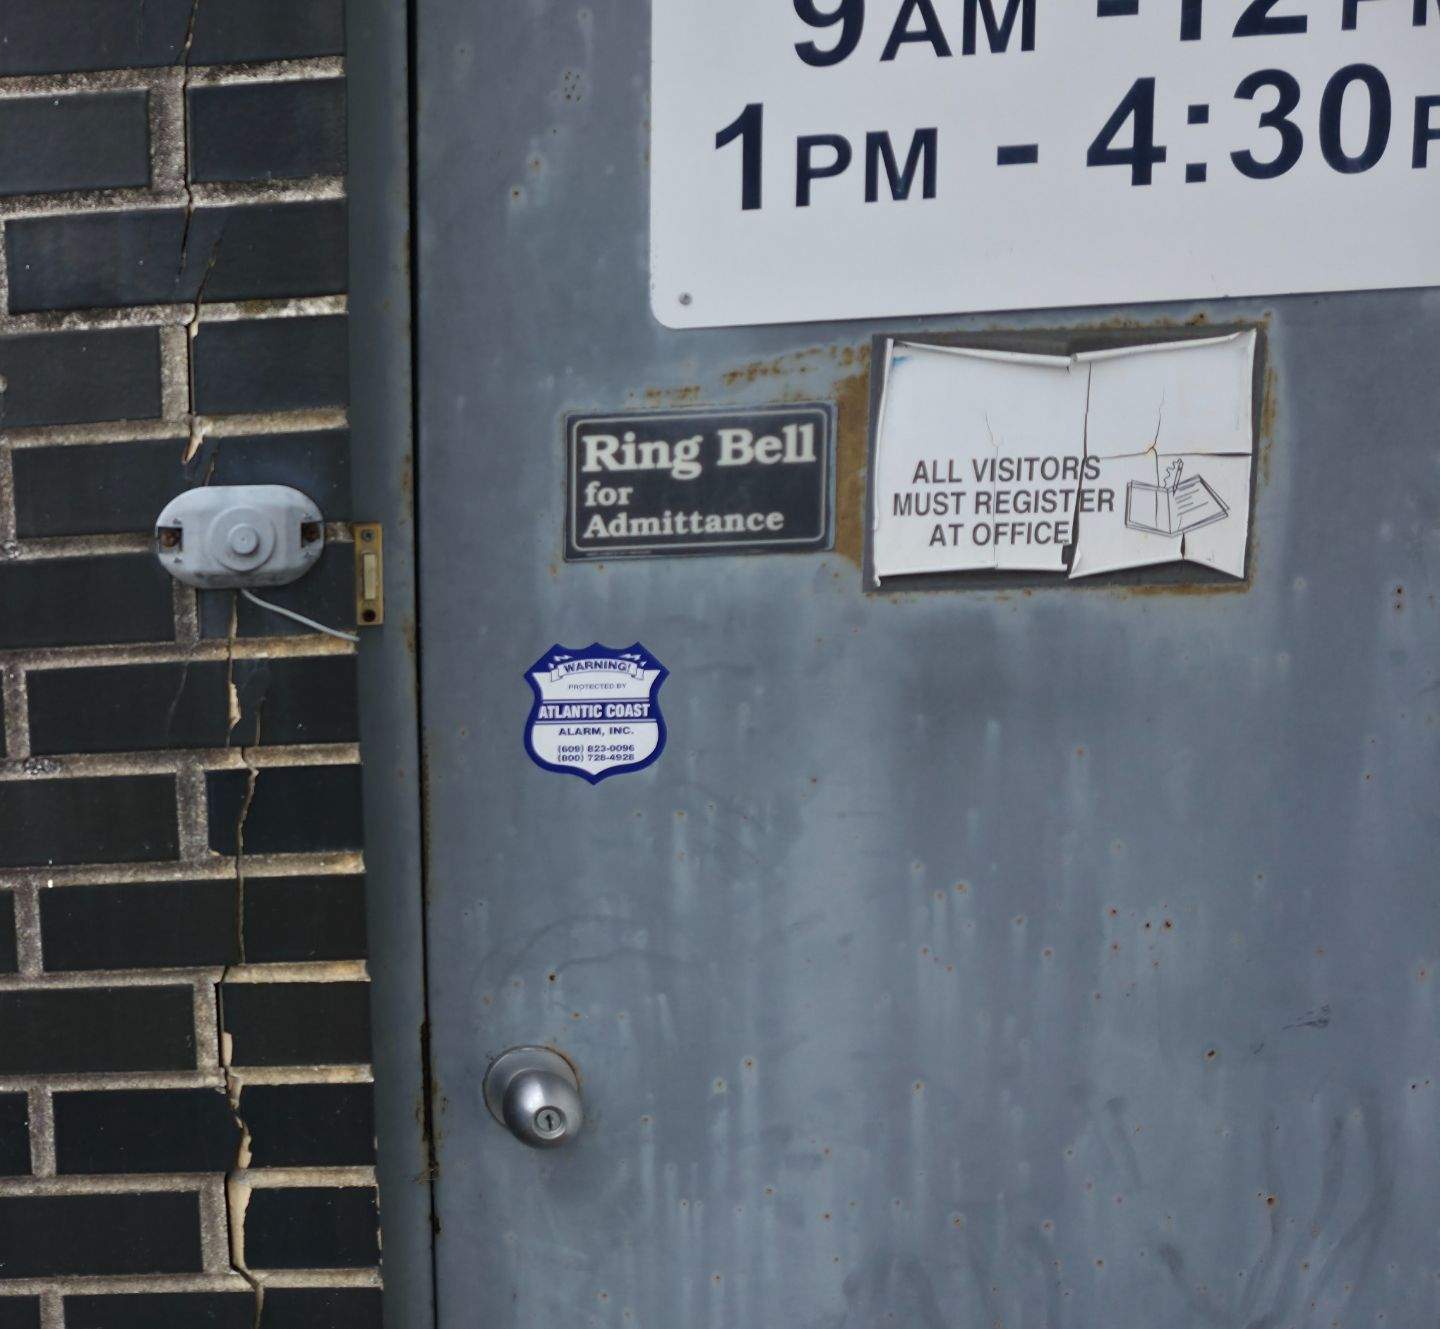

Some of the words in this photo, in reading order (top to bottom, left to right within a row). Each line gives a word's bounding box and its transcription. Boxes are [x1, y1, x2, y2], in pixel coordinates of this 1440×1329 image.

[793, 0, 1036, 67] 9AM
[715, 102, 938, 211] 1PM
[581, 431, 704, 480] Ring
[716, 423, 816, 466] Bell
[912, 459, 962, 485] ALL
[972, 455, 1102, 482] VISITORS
[584, 481, 634, 506] for
[892, 491, 967, 517] MUST
[973, 488, 1116, 515] REGISTER
[582, 510, 785, 539] Admittance
[928, 524, 965, 547] AT
[971, 521, 1071, 546] OFFICE
[564, 660, 632, 673] WARNING!
[538, 704, 603, 719] ATLANTIC
[605, 703, 651, 718] COAST
[558, 727, 605, 736] ALARM,
[609, 726, 635, 735] INC.
